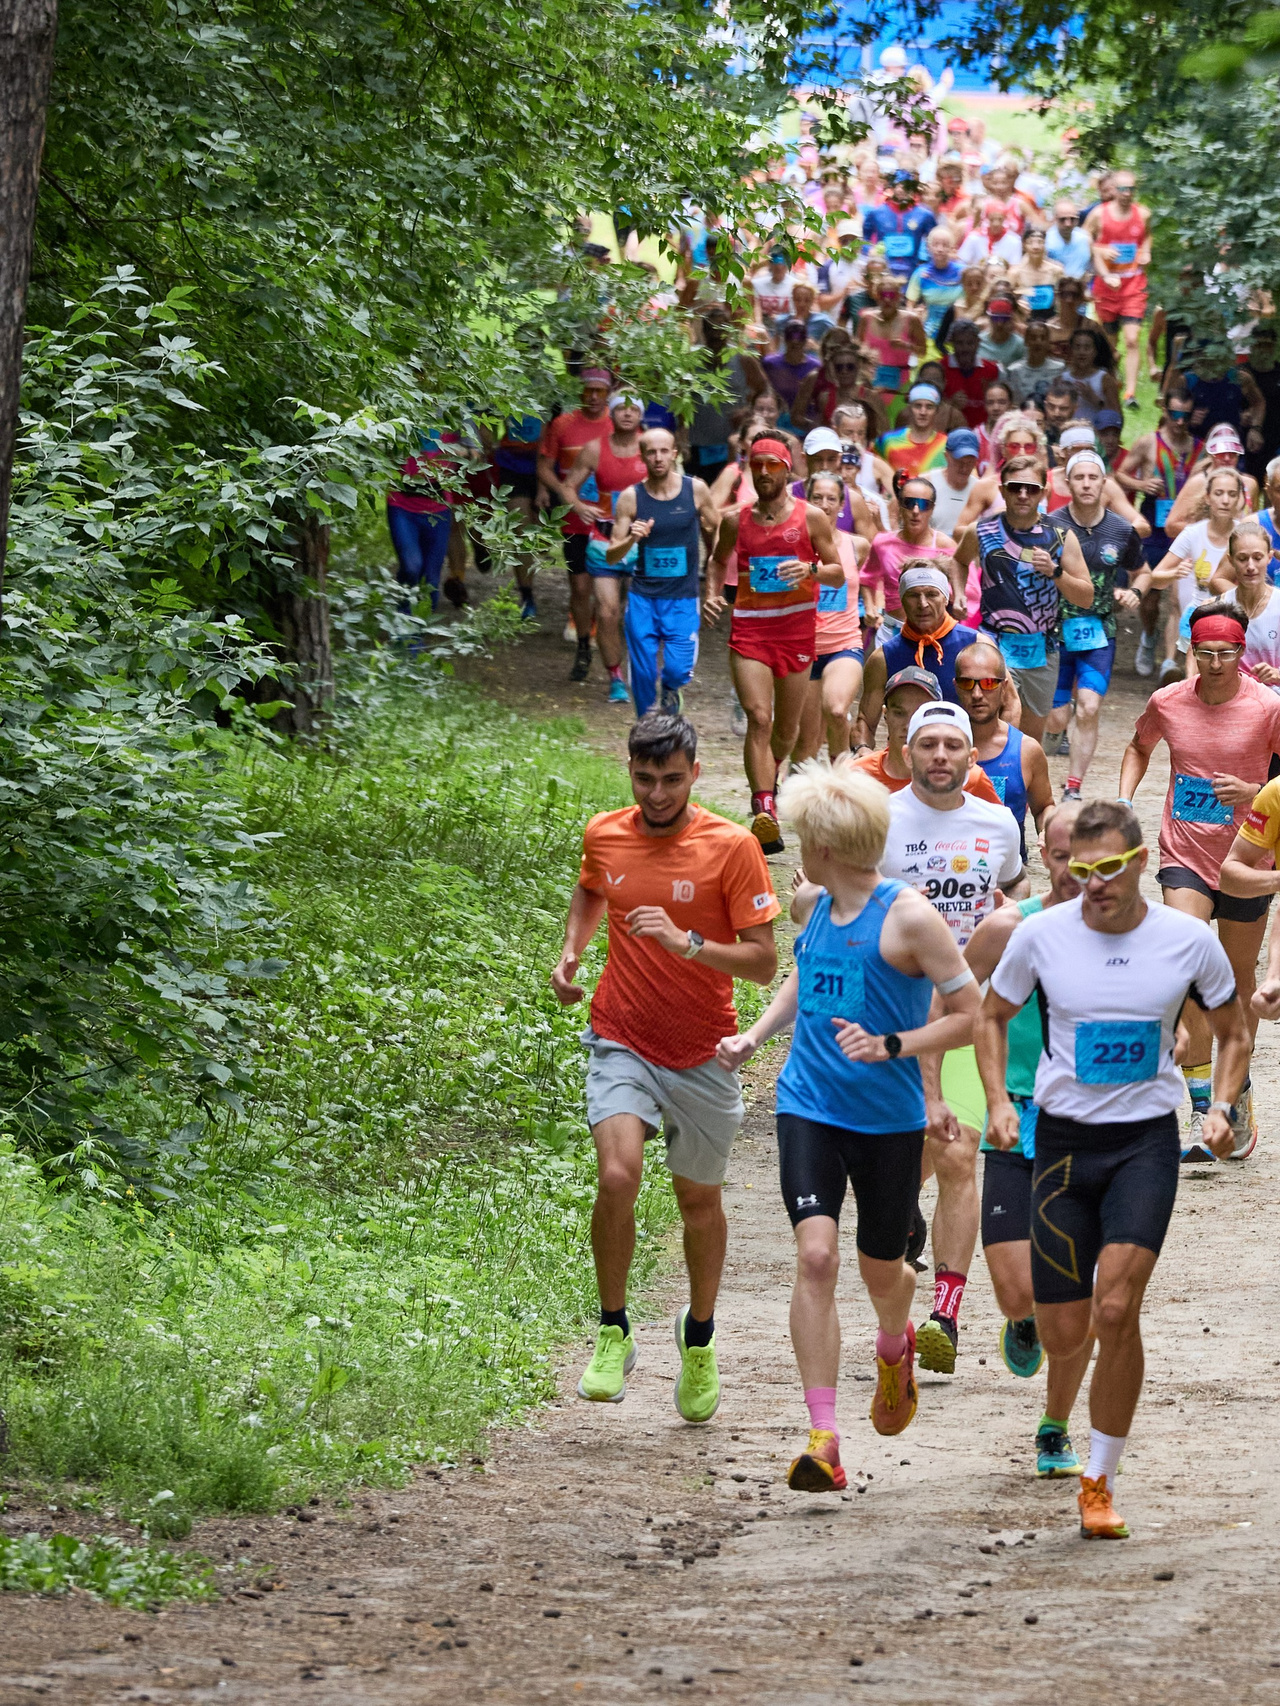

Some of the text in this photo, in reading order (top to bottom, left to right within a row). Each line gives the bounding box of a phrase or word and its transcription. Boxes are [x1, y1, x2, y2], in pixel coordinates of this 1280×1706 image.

[652, 557, 679, 569] 239
[759, 567, 779, 582] 24
[820, 590, 840, 603] 77
[1072, 627, 1097, 640] 291
[1010, 644, 1038, 658] 257
[1183, 790, 1220, 810] 277
[671, 879, 695, 904] 10
[813, 971, 844, 997] 211
[1092, 1041, 1146, 1064] 229
